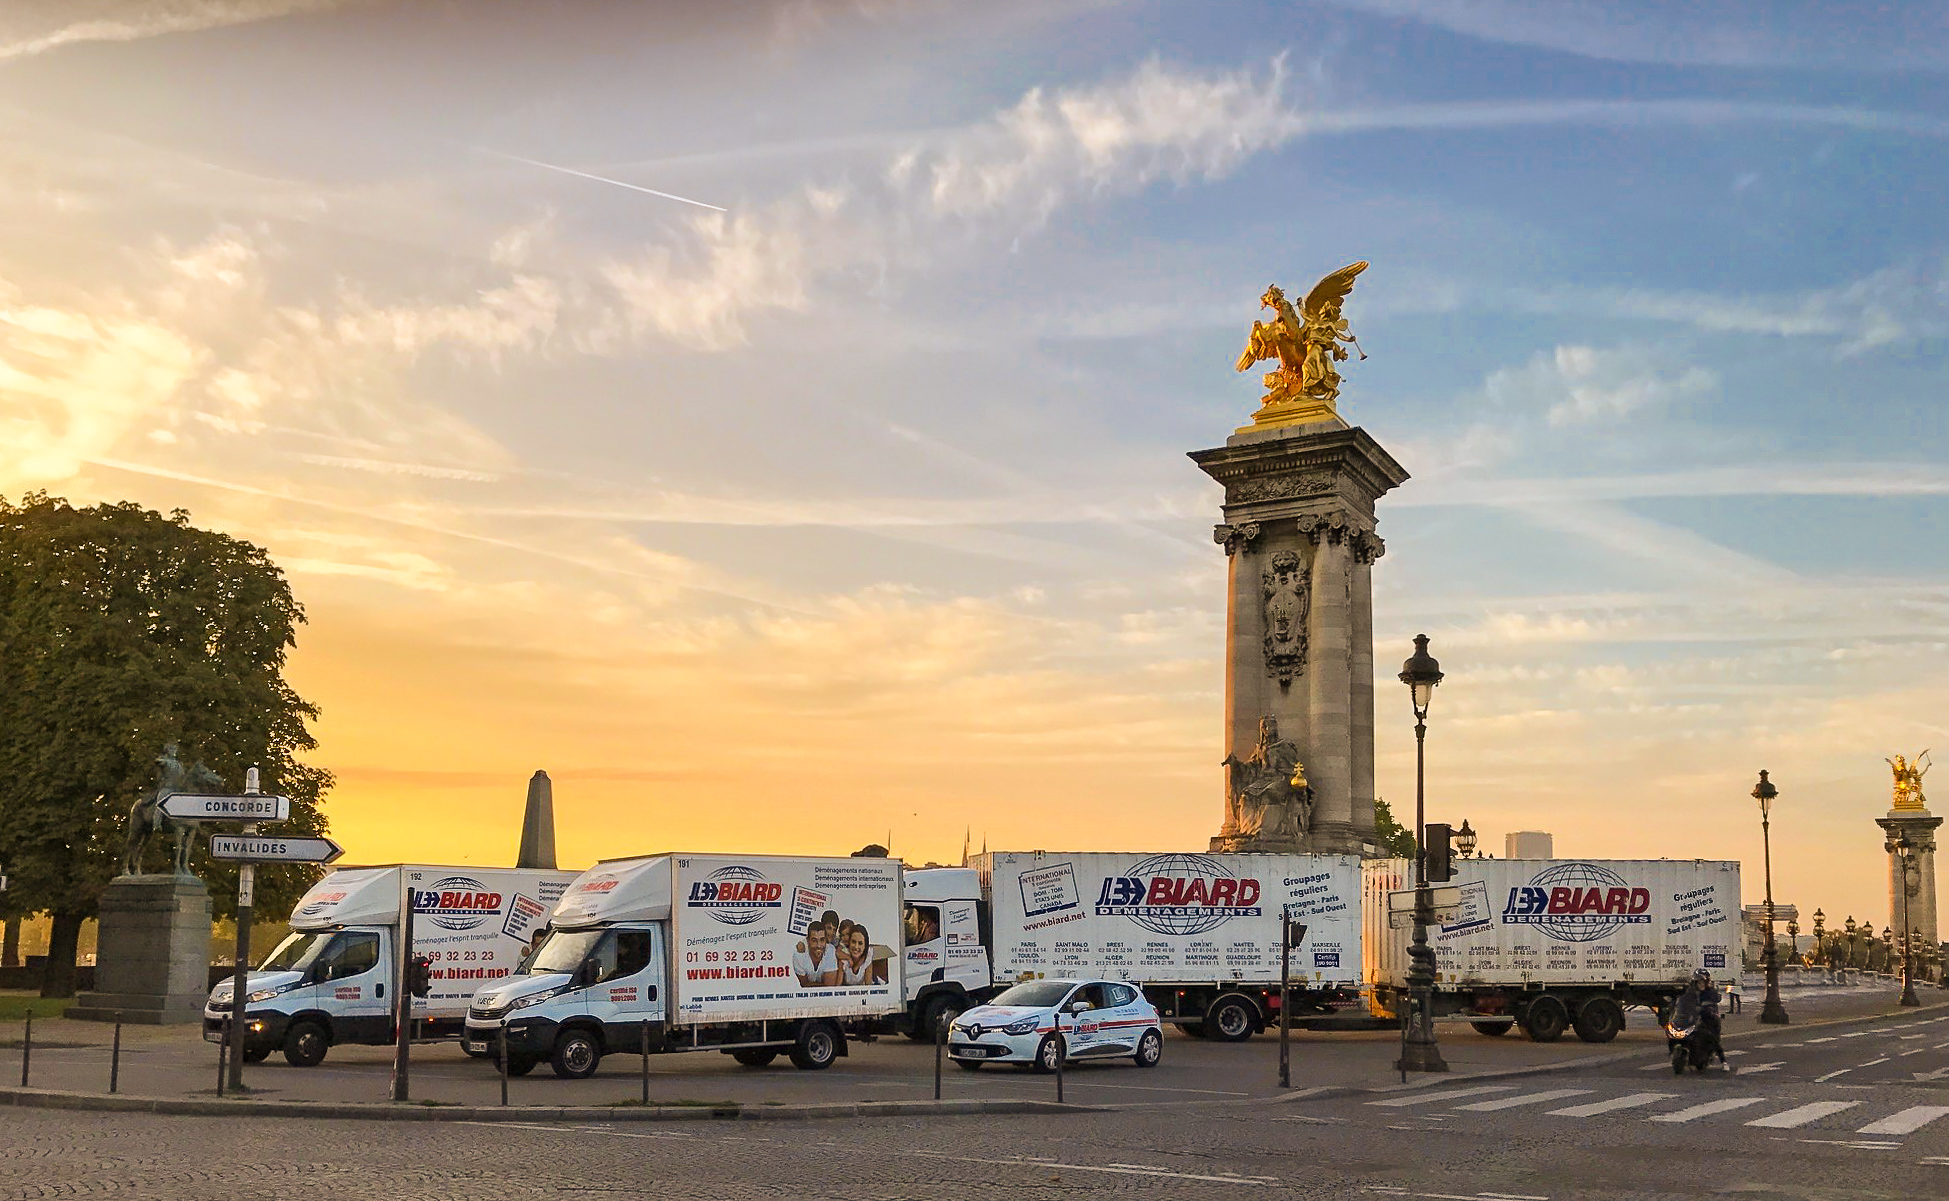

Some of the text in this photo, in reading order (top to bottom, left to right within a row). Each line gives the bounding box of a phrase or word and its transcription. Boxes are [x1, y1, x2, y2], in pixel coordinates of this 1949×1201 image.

[205, 801, 272, 813] CONCORDE
[217, 841, 287, 854] INVALIDES
[678, 860, 690, 868] 191
[1283, 872, 1330, 886] Groupages
[717, 882, 782, 901] BIARD
[1145, 877, 1261, 906] BIARD
[1290, 885, 1328, 897] réguliers
[1674, 885, 1714, 901] Groupages
[439, 891, 502, 910] BIARD
[1040, 900, 1062, 910] CANADA
[1283, 900, 1315, 910] Bretagne
[1321, 895, 1339, 903] Paris
[1548, 887, 1650, 914] BIARD
[1680, 897, 1713, 911] réguliers
[1099, 907, 1258, 916] DEMENAGEMENTS
[1279, 911, 1292, 920] Sd
[1294, 910, 1305, 918] Est
[1325, 903, 1346, 912] Ouest
[1671, 913, 1700, 924] Bretagne
[1705, 908, 1721, 916] Paris
[1023, 911, 1086, 931] www.biard.net
[1667, 926, 1680, 934] Sud
[1708, 915, 1727, 924] Ouest
[726, 932, 747, 941] l'esprit
[748, 927, 778, 937] tranquille
[1437, 923, 1494, 942] www.biard.net
[428, 952, 441, 960] 69
[446, 952, 459, 960] 32
[464, 952, 477, 960] 23
[481, 952, 494, 960] 23
[686, 950, 774, 962] 01 69 32 23 23
[686, 965, 790, 980] www.biard.net
